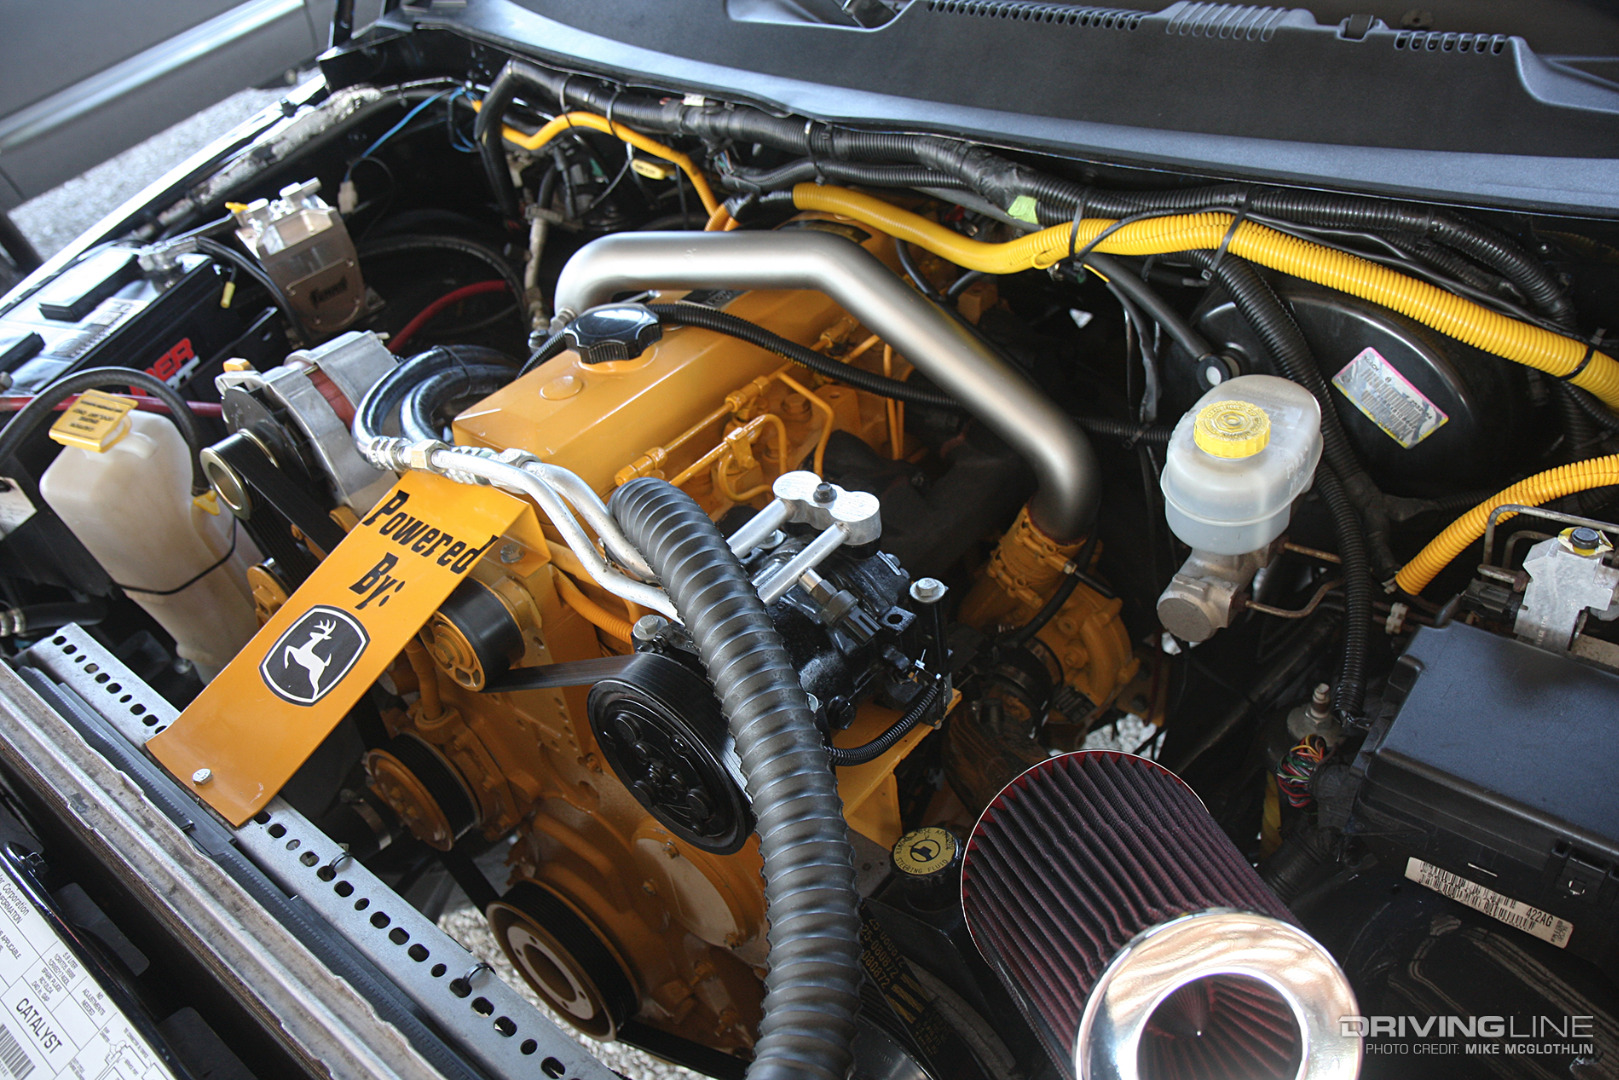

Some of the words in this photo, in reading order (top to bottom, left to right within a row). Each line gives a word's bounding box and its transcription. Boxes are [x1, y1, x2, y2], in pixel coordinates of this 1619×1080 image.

[361, 489, 499, 575] Powered
[348, 551, 406, 611] By:
[2, 883, 30, 917] Corporation
[1525, 907, 1554, 927] 422AG
[16, 998, 63, 1054] CATALYST
